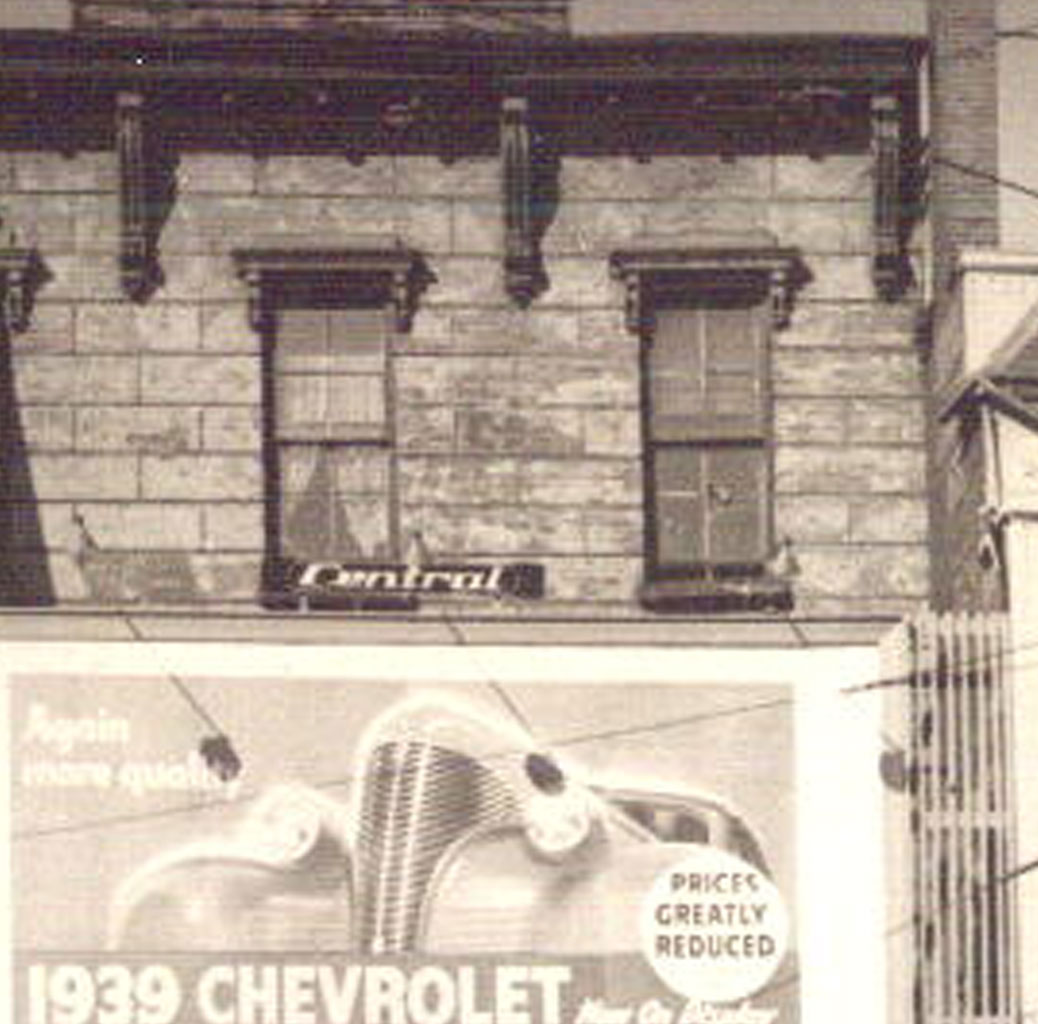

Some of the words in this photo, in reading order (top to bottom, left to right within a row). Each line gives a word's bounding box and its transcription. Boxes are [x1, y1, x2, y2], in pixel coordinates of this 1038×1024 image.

[299, 563, 498, 590] Central
[20, 702, 131, 753] Again
[670, 872, 760, 894] PRICES
[654, 902, 768, 926] GREATLY
[654, 933, 776, 959] REDUCED
